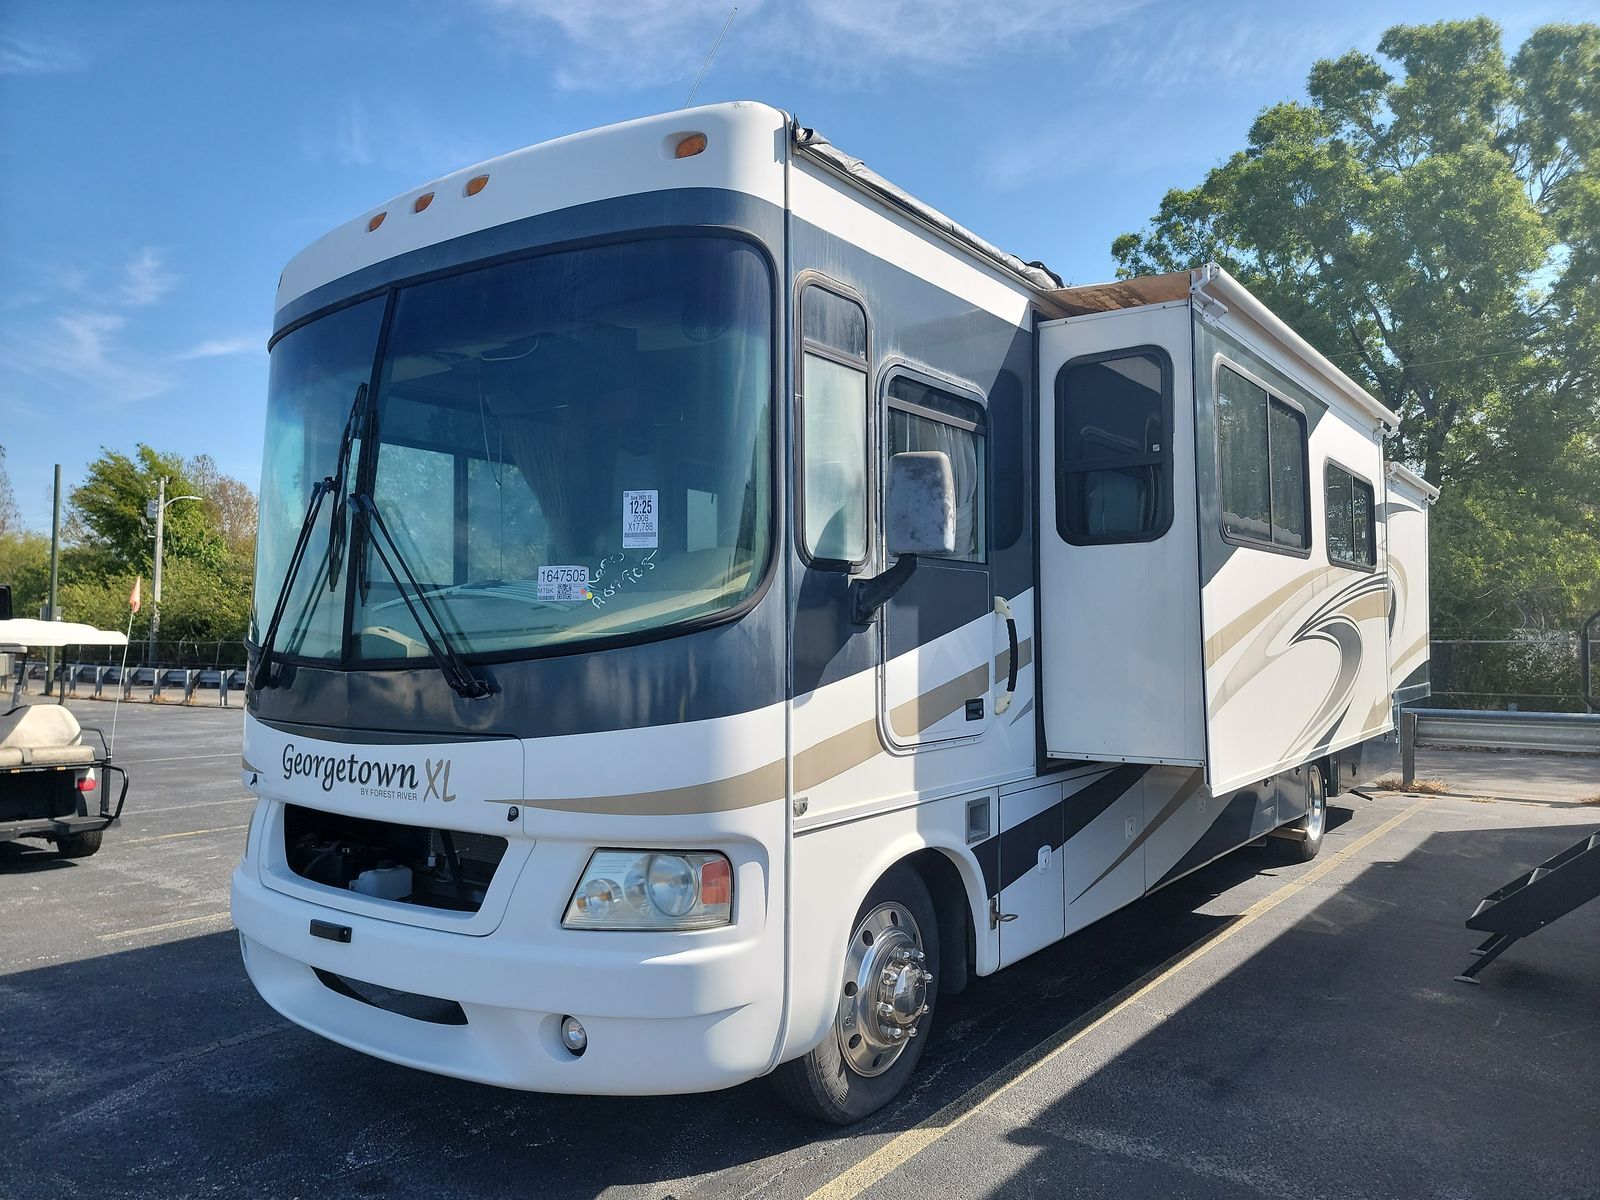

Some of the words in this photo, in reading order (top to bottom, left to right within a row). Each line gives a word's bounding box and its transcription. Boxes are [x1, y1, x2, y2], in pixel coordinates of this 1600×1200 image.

[630, 500, 652, 514] 12:25
[633, 514, 649, 523] 2008
[541, 569, 586, 583] 1647505
[282, 743, 419, 792] Georgetown
[423, 758, 457, 803] XL
[360, 787, 369, 796] BY
[370, 788, 396, 799] FOREST
[396, 790, 418, 801] RIVER
